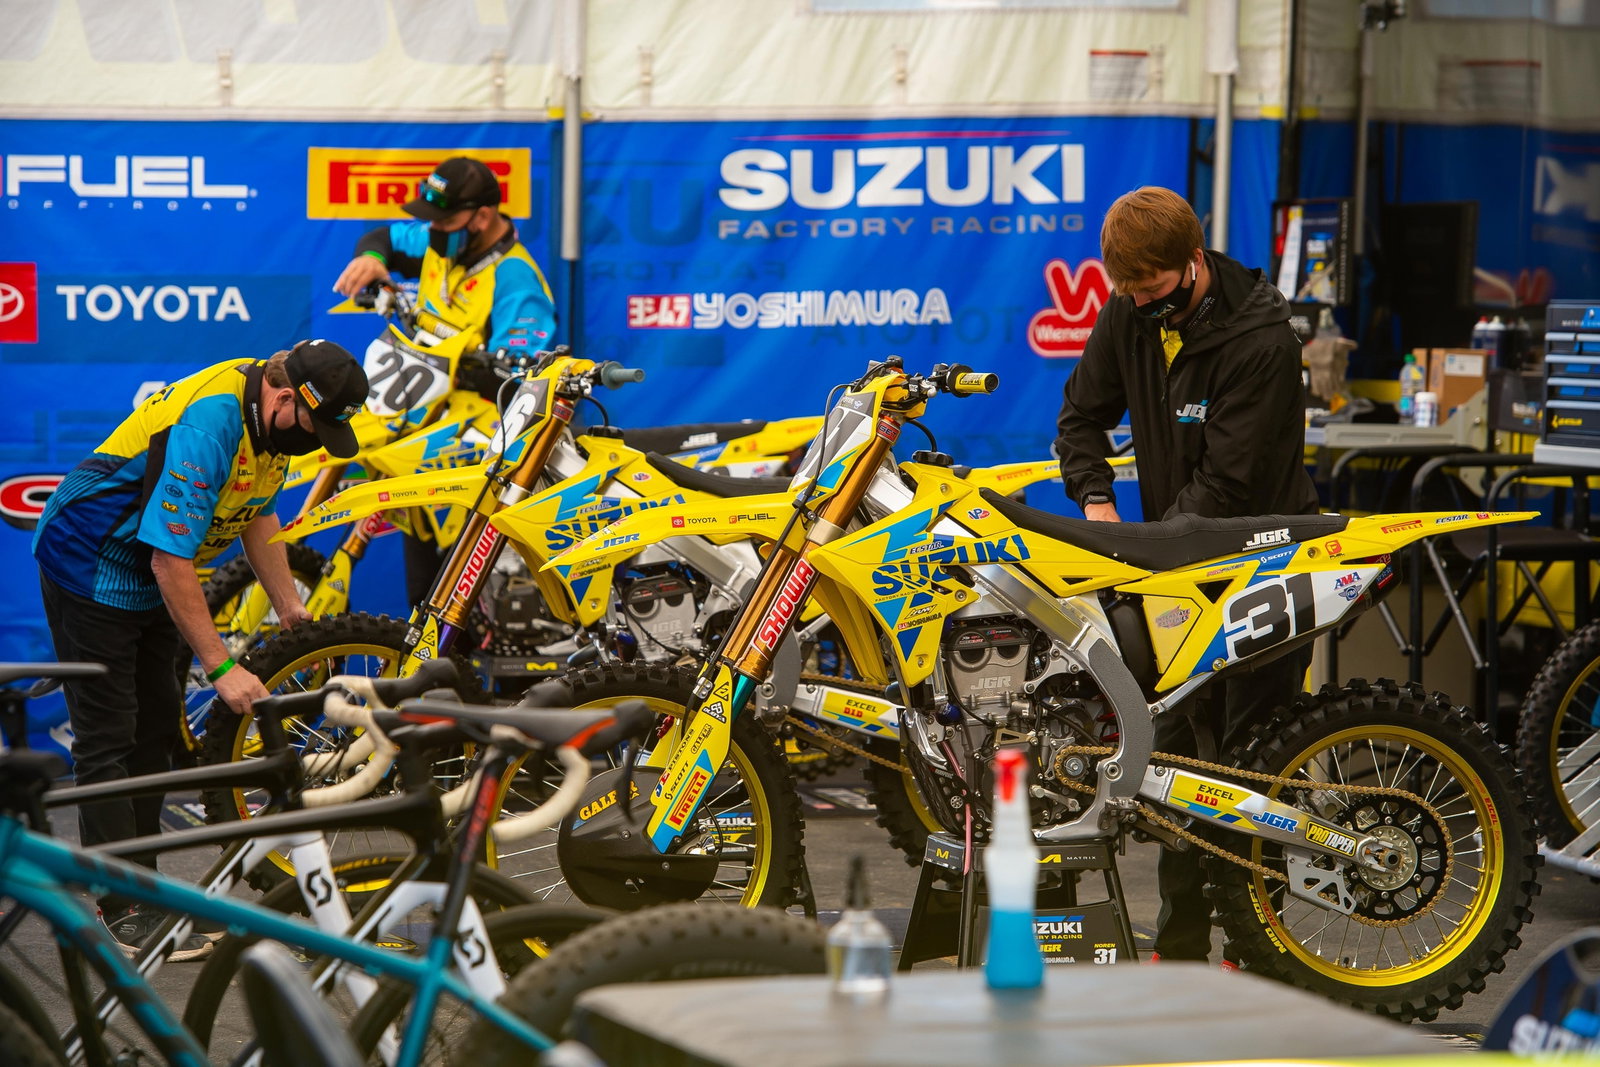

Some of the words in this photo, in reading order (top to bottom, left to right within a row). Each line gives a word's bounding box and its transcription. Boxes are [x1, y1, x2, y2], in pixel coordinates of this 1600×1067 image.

[328, 162, 510, 204] PIRI
[719, 144, 1084, 210] SUZUKI
[719, 217, 915, 239] FACTORY
[931, 214, 1084, 234] RACING
[56, 285, 250, 321] TOYOTA
[694, 288, 951, 328] YOSHIMURA
[364, 352, 434, 411] 20
[1176, 403, 1207, 420] JG
[313, 510, 352, 527] JGR
[738, 513, 776, 522] FUEL
[1381, 519, 1423, 534] PIRELLI
[1436, 514, 1469, 525] ECSTAR
[595, 533, 640, 550] JGR
[910, 541, 944, 554] ECSTAR
[1246, 528, 1291, 546] JGR
[457, 521, 500, 600] SHOWA
[872, 534, 1031, 597] SUZUKI
[1268, 550, 1293, 560] SCOTT
[1334, 572, 1361, 590] AMA
[758, 558, 815, 652] SHOWA
[1229, 573, 1316, 659] 31
[970, 676, 1011, 689] JGR
[846, 699, 878, 712] EXCEL
[668, 729, 694, 771] PISTONS
[670, 760, 688, 791] SCOTT
[579, 780, 638, 821] GALFR
[669, 771, 707, 825] PIRELLI
[1198, 784, 1235, 801] EXCEL
[1252, 811, 1299, 833] JGR
[1484, 797, 1498, 826] EXCEL
[1247, 882, 1268, 924] SOFT
[1262, 900, 1278, 927] EXCEL
[1033, 922, 1082, 934] ZUKI
[1265, 927, 1287, 953] MID
[1093, 948, 1117, 965] 31
